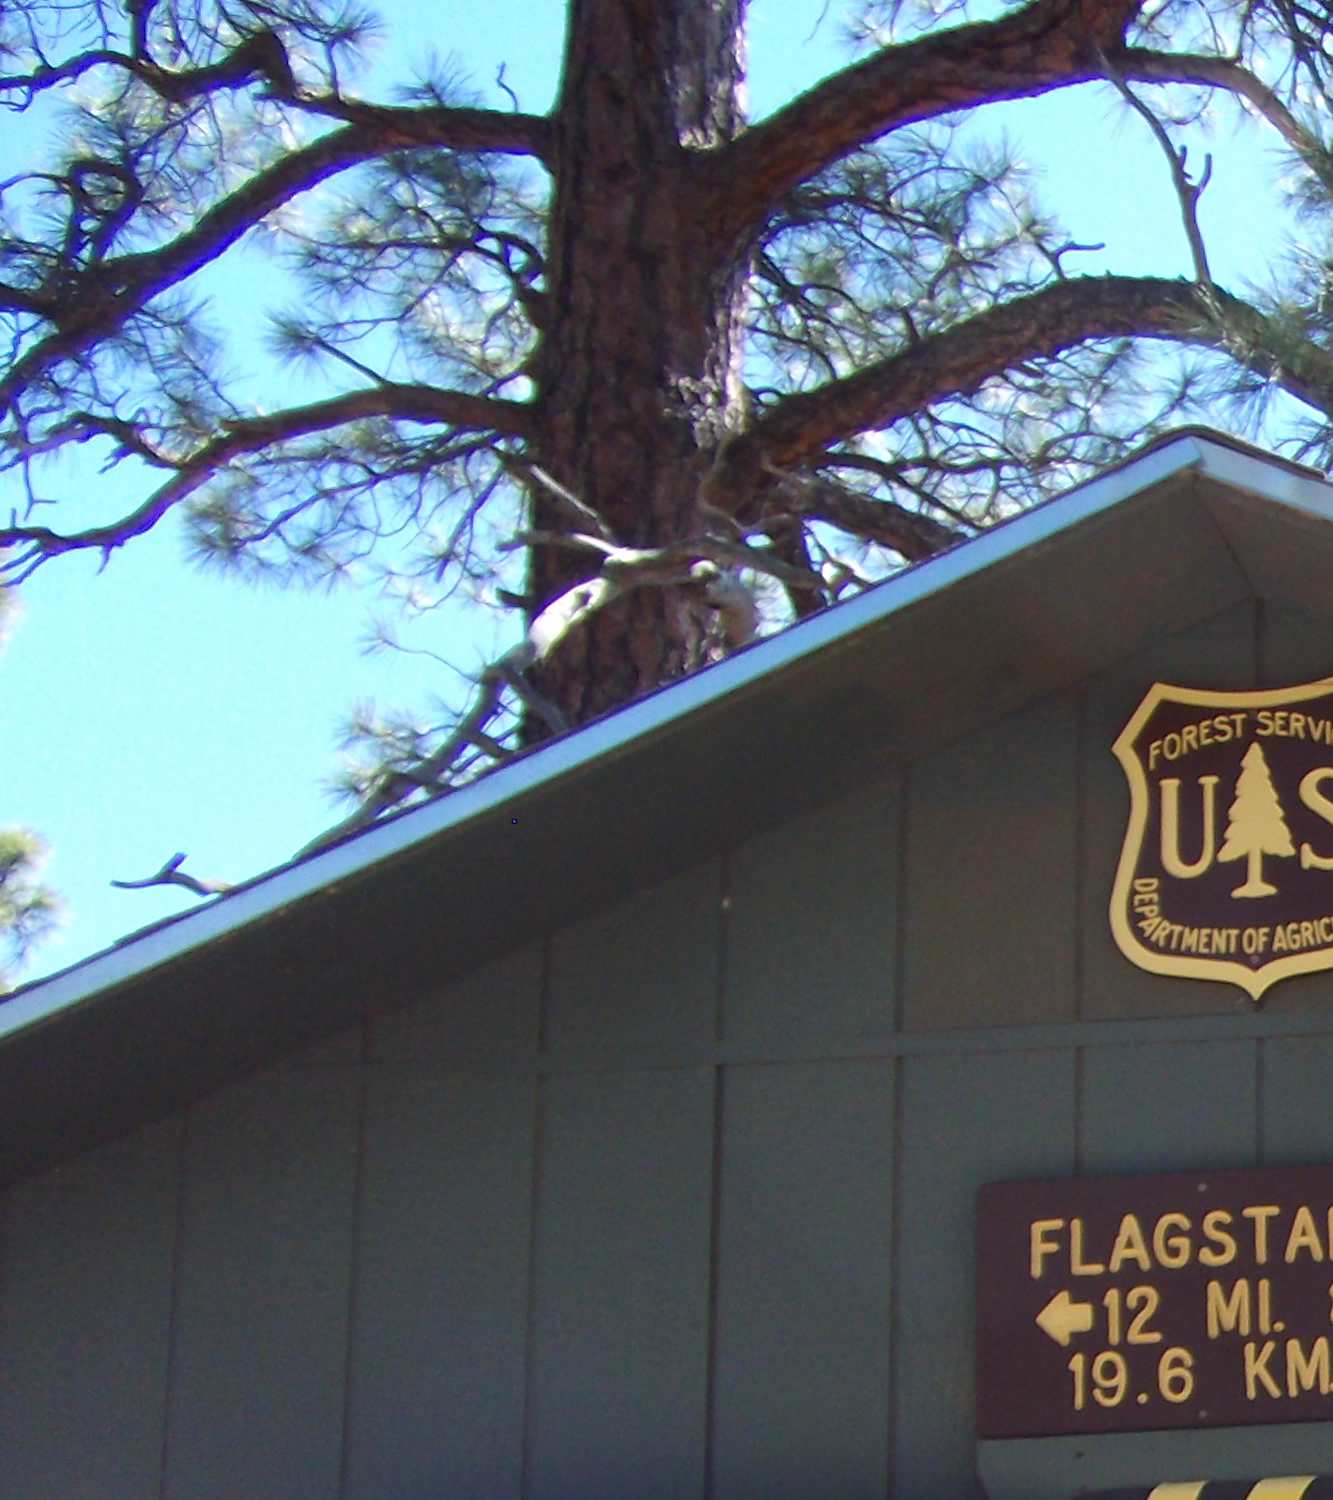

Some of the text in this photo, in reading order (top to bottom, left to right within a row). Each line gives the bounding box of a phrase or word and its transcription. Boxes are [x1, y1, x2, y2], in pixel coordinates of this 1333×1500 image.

[1150, 713, 1247, 771] FOREST
[1133, 877, 1240, 954] DEPARTMENT
[1242, 927, 1270, 953] OF
[1104, 1277, 1286, 1346] 12 MI.
[1069, 1347, 1194, 1410] 19.6
